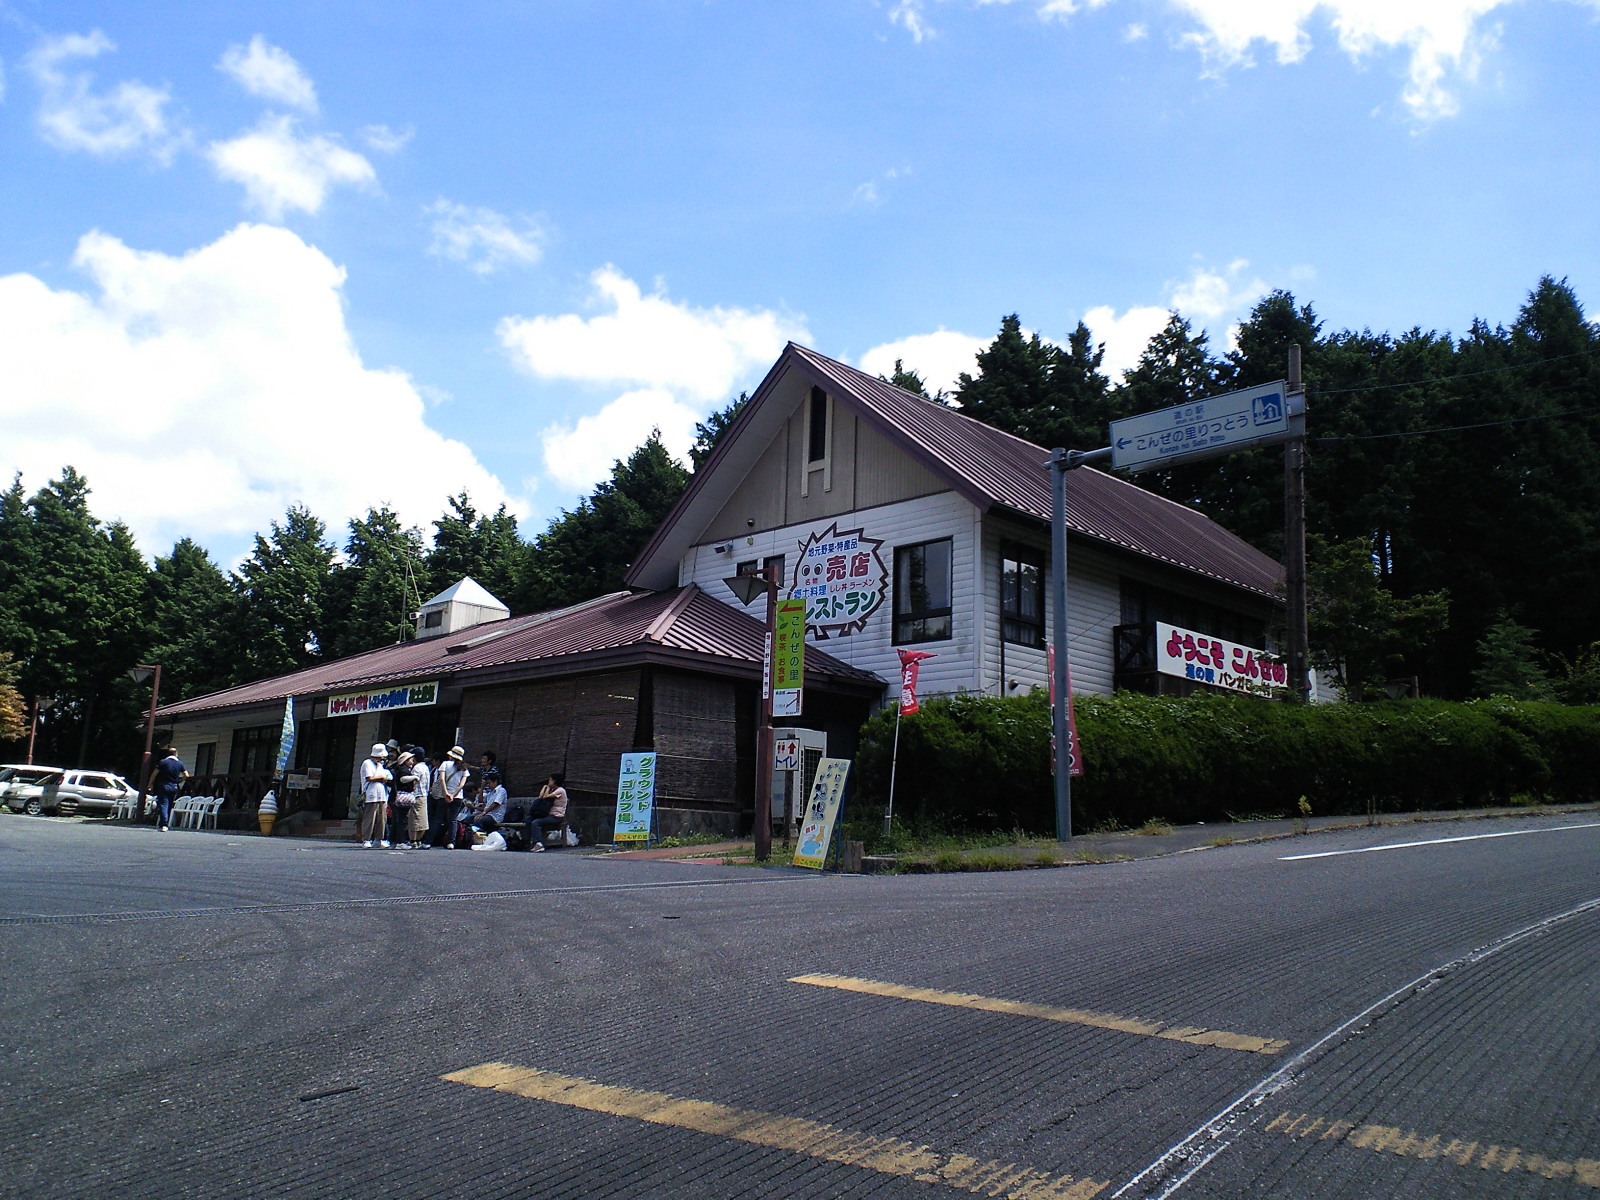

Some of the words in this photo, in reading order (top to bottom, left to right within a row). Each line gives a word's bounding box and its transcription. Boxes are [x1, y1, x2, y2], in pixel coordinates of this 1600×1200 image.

[1173, 405, 1205, 420] 道の駅
[826, 551, 871, 582] 売店
[829, 583, 848, 593] しし丼
[849, 579, 875, 590] ラーメン
[789, 616, 800, 681] こんぜの里
[1166, 630, 1225, 669] ようこそ
[1185, 663, 1215, 684] 道の駅
[775, 756, 798, 769] トイレ
[637, 756, 655, 812] グラウンド
[618, 779, 635, 823] ゴルフ場
